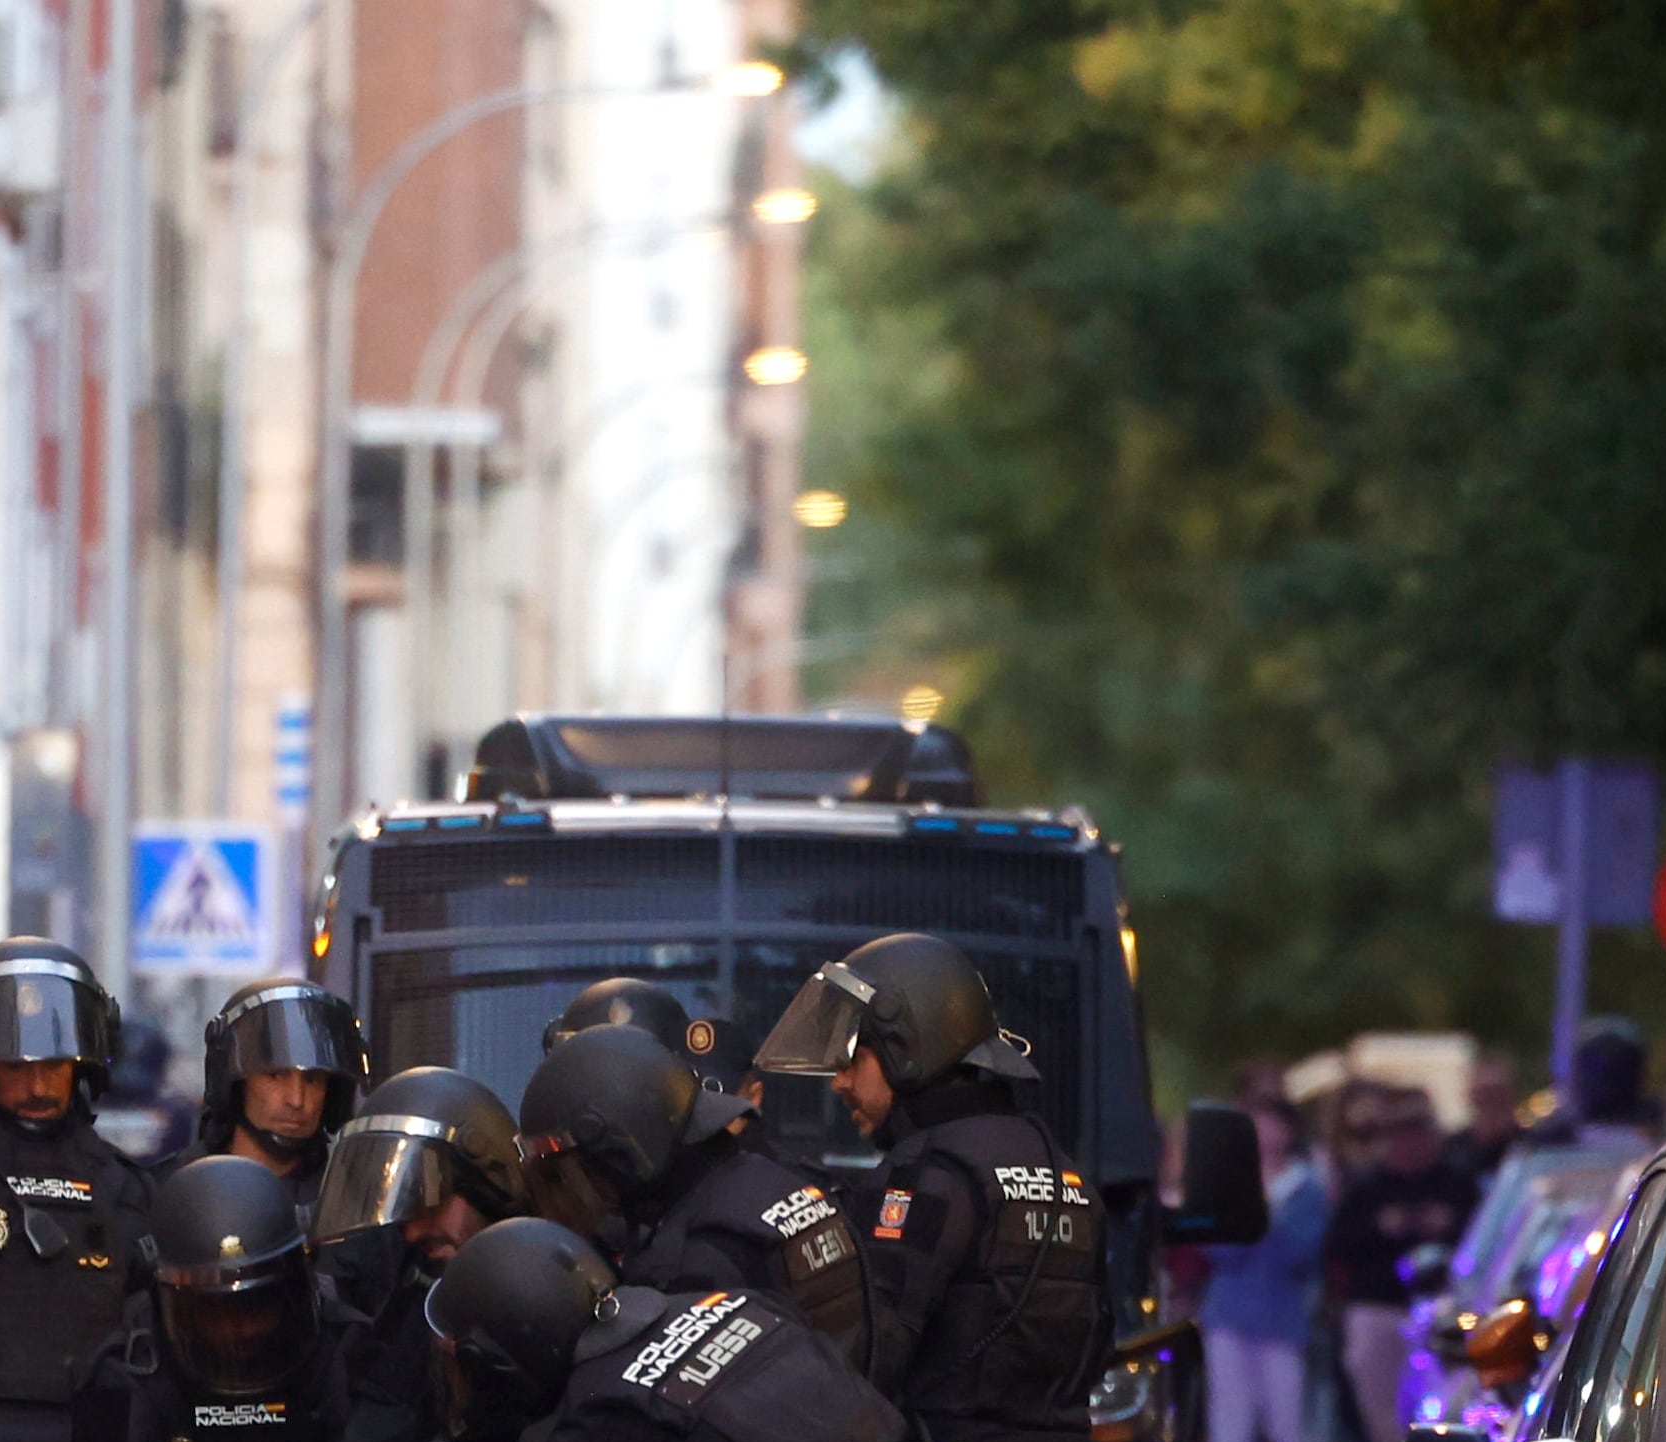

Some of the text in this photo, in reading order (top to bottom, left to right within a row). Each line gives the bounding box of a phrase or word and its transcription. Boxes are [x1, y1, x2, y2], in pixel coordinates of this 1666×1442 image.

[11, 1184, 93, 1201] NACIONAL
[621, 1304, 711, 1384] POLICIA
[638, 1294, 748, 1389] NACIONAL
[678, 1316, 764, 1388] 1U253
[194, 1404, 267, 1418] POLICIA
[195, 1413, 287, 1427] NACIONAL
